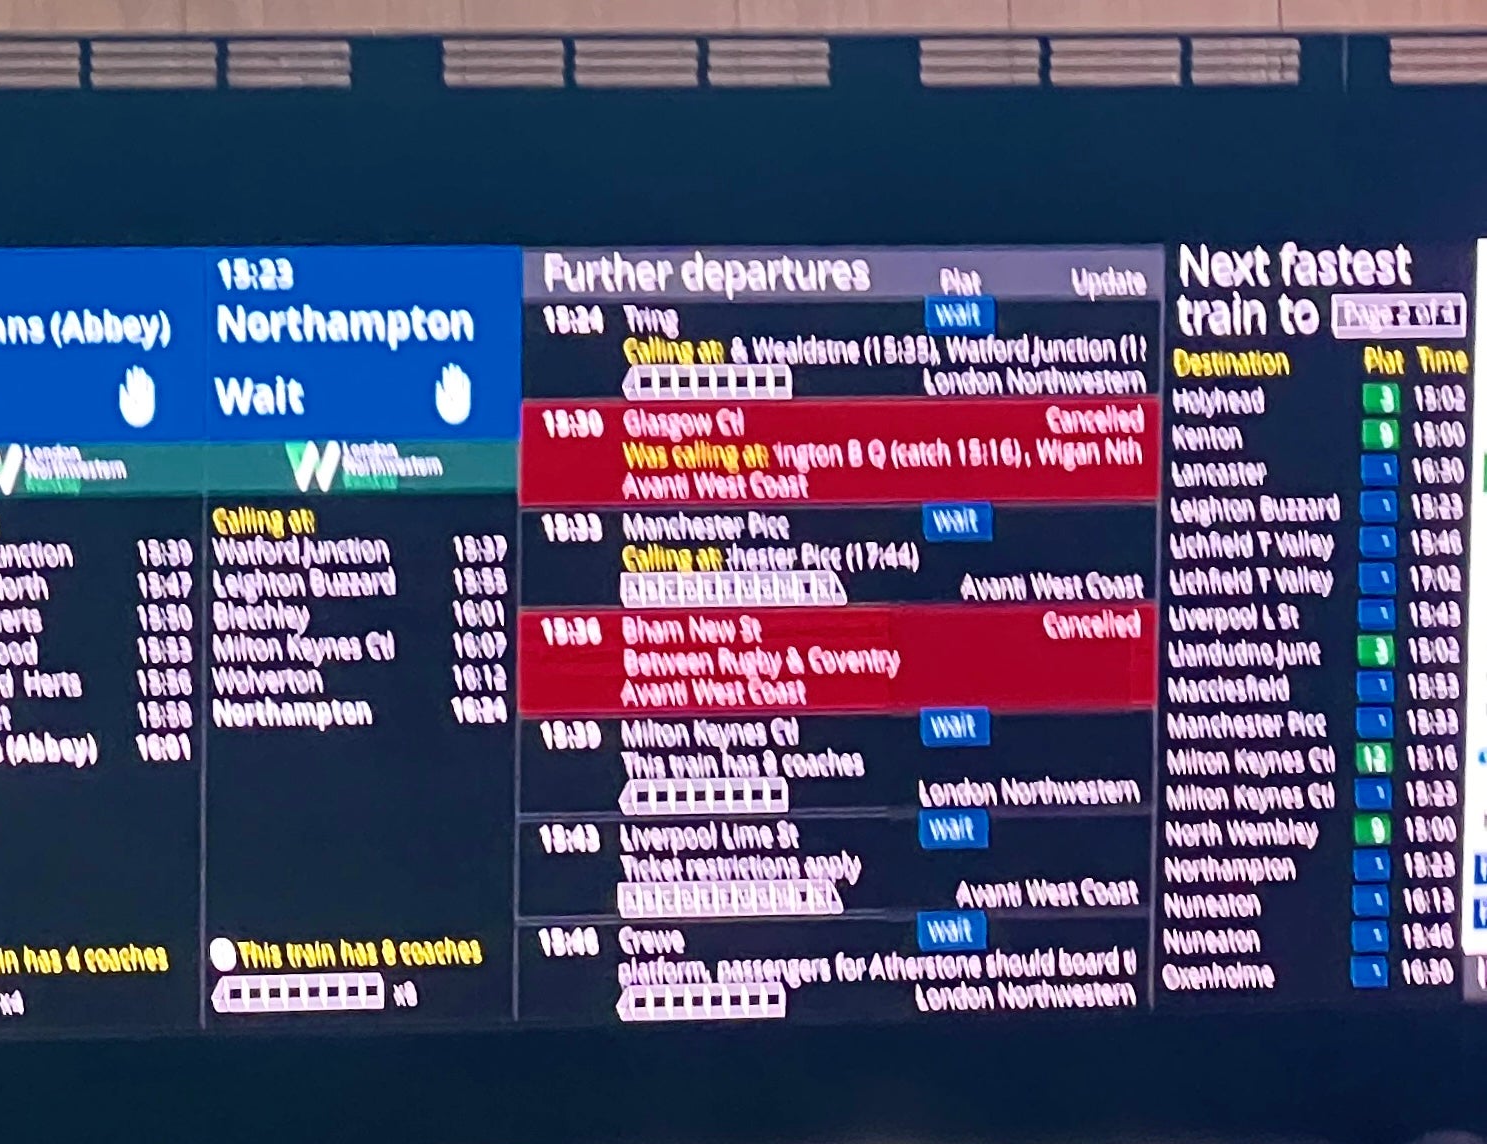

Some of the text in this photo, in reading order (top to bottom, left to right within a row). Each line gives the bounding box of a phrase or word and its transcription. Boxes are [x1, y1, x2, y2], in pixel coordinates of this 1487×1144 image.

[543, 250, 871, 301] Further departures
[1179, 241, 1412, 288] Next fastest
[939, 266, 982, 296] Plat
[1071, 266, 1148, 301] Update
[50, 308, 172, 351] (Abbey)
[217, 304, 475, 351] Northampton
[623, 304, 679, 339] Tring
[1177, 291, 1267, 337] train
[1278, 293, 1320, 336] to
[1173, 348, 1291, 378] Destination
[1364, 346, 1405, 375] Plat
[1416, 346, 1469, 375] Time
[214, 375, 305, 416] Wait
[923, 366, 1147, 396] London Northwestern
[1172, 386, 1265, 418] Holyhead
[1045, 403, 1145, 434] Cancelled
[622, 470, 810, 500] Avanti West Coast
[960, 571, 1144, 601] Avanti West Coast
[1042, 609, 1142, 639] Cancelled
[623, 648, 715, 677] Between
[717, 645, 783, 680] Rugby
[807, 645, 901, 680] Coventry
[212, 696, 373, 731] Northampton
[6, 732, 98, 768] (Abbey)
[918, 776, 1141, 807] London Northwestern
[1165, 818, 1319, 850] North Wembley
[1164, 855, 1297, 886] Northampton
[955, 877, 1139, 908] Avanti West Coast
[619, 926, 686, 955] Crewe
[926, 917, 973, 944] Wait
[717, 946, 1120, 989] passengers for Atherstone should board
[1162, 961, 1276, 991] Oxenholme
[915, 980, 1137, 1012] London Northwestern
